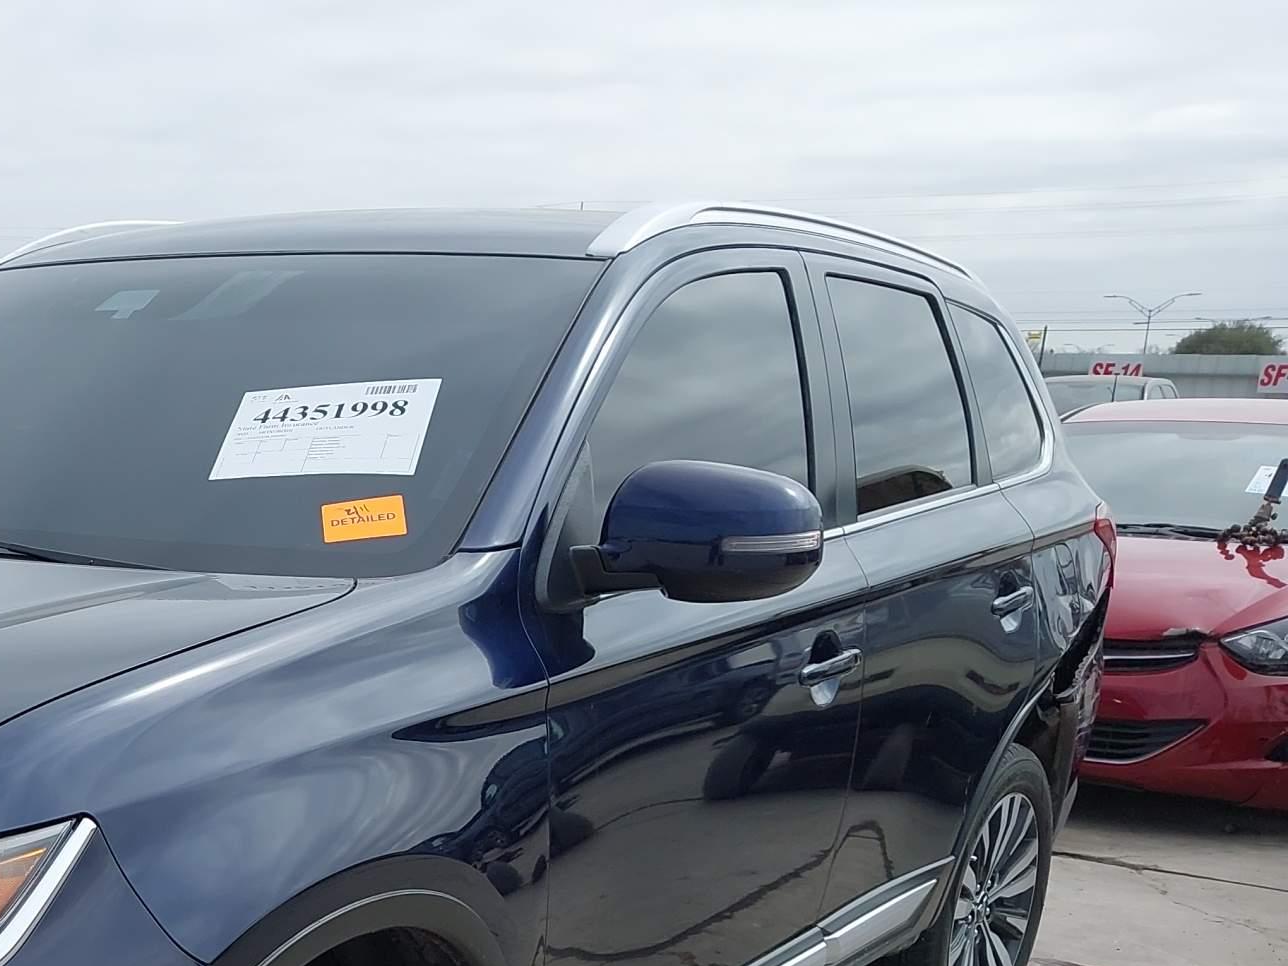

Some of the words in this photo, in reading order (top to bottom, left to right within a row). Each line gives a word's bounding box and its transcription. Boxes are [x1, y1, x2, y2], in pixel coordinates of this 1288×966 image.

[1259, 364, 1288, 387] SF
[252, 399, 409, 424] 44351998
[330, 512, 397, 527] DETAILED
